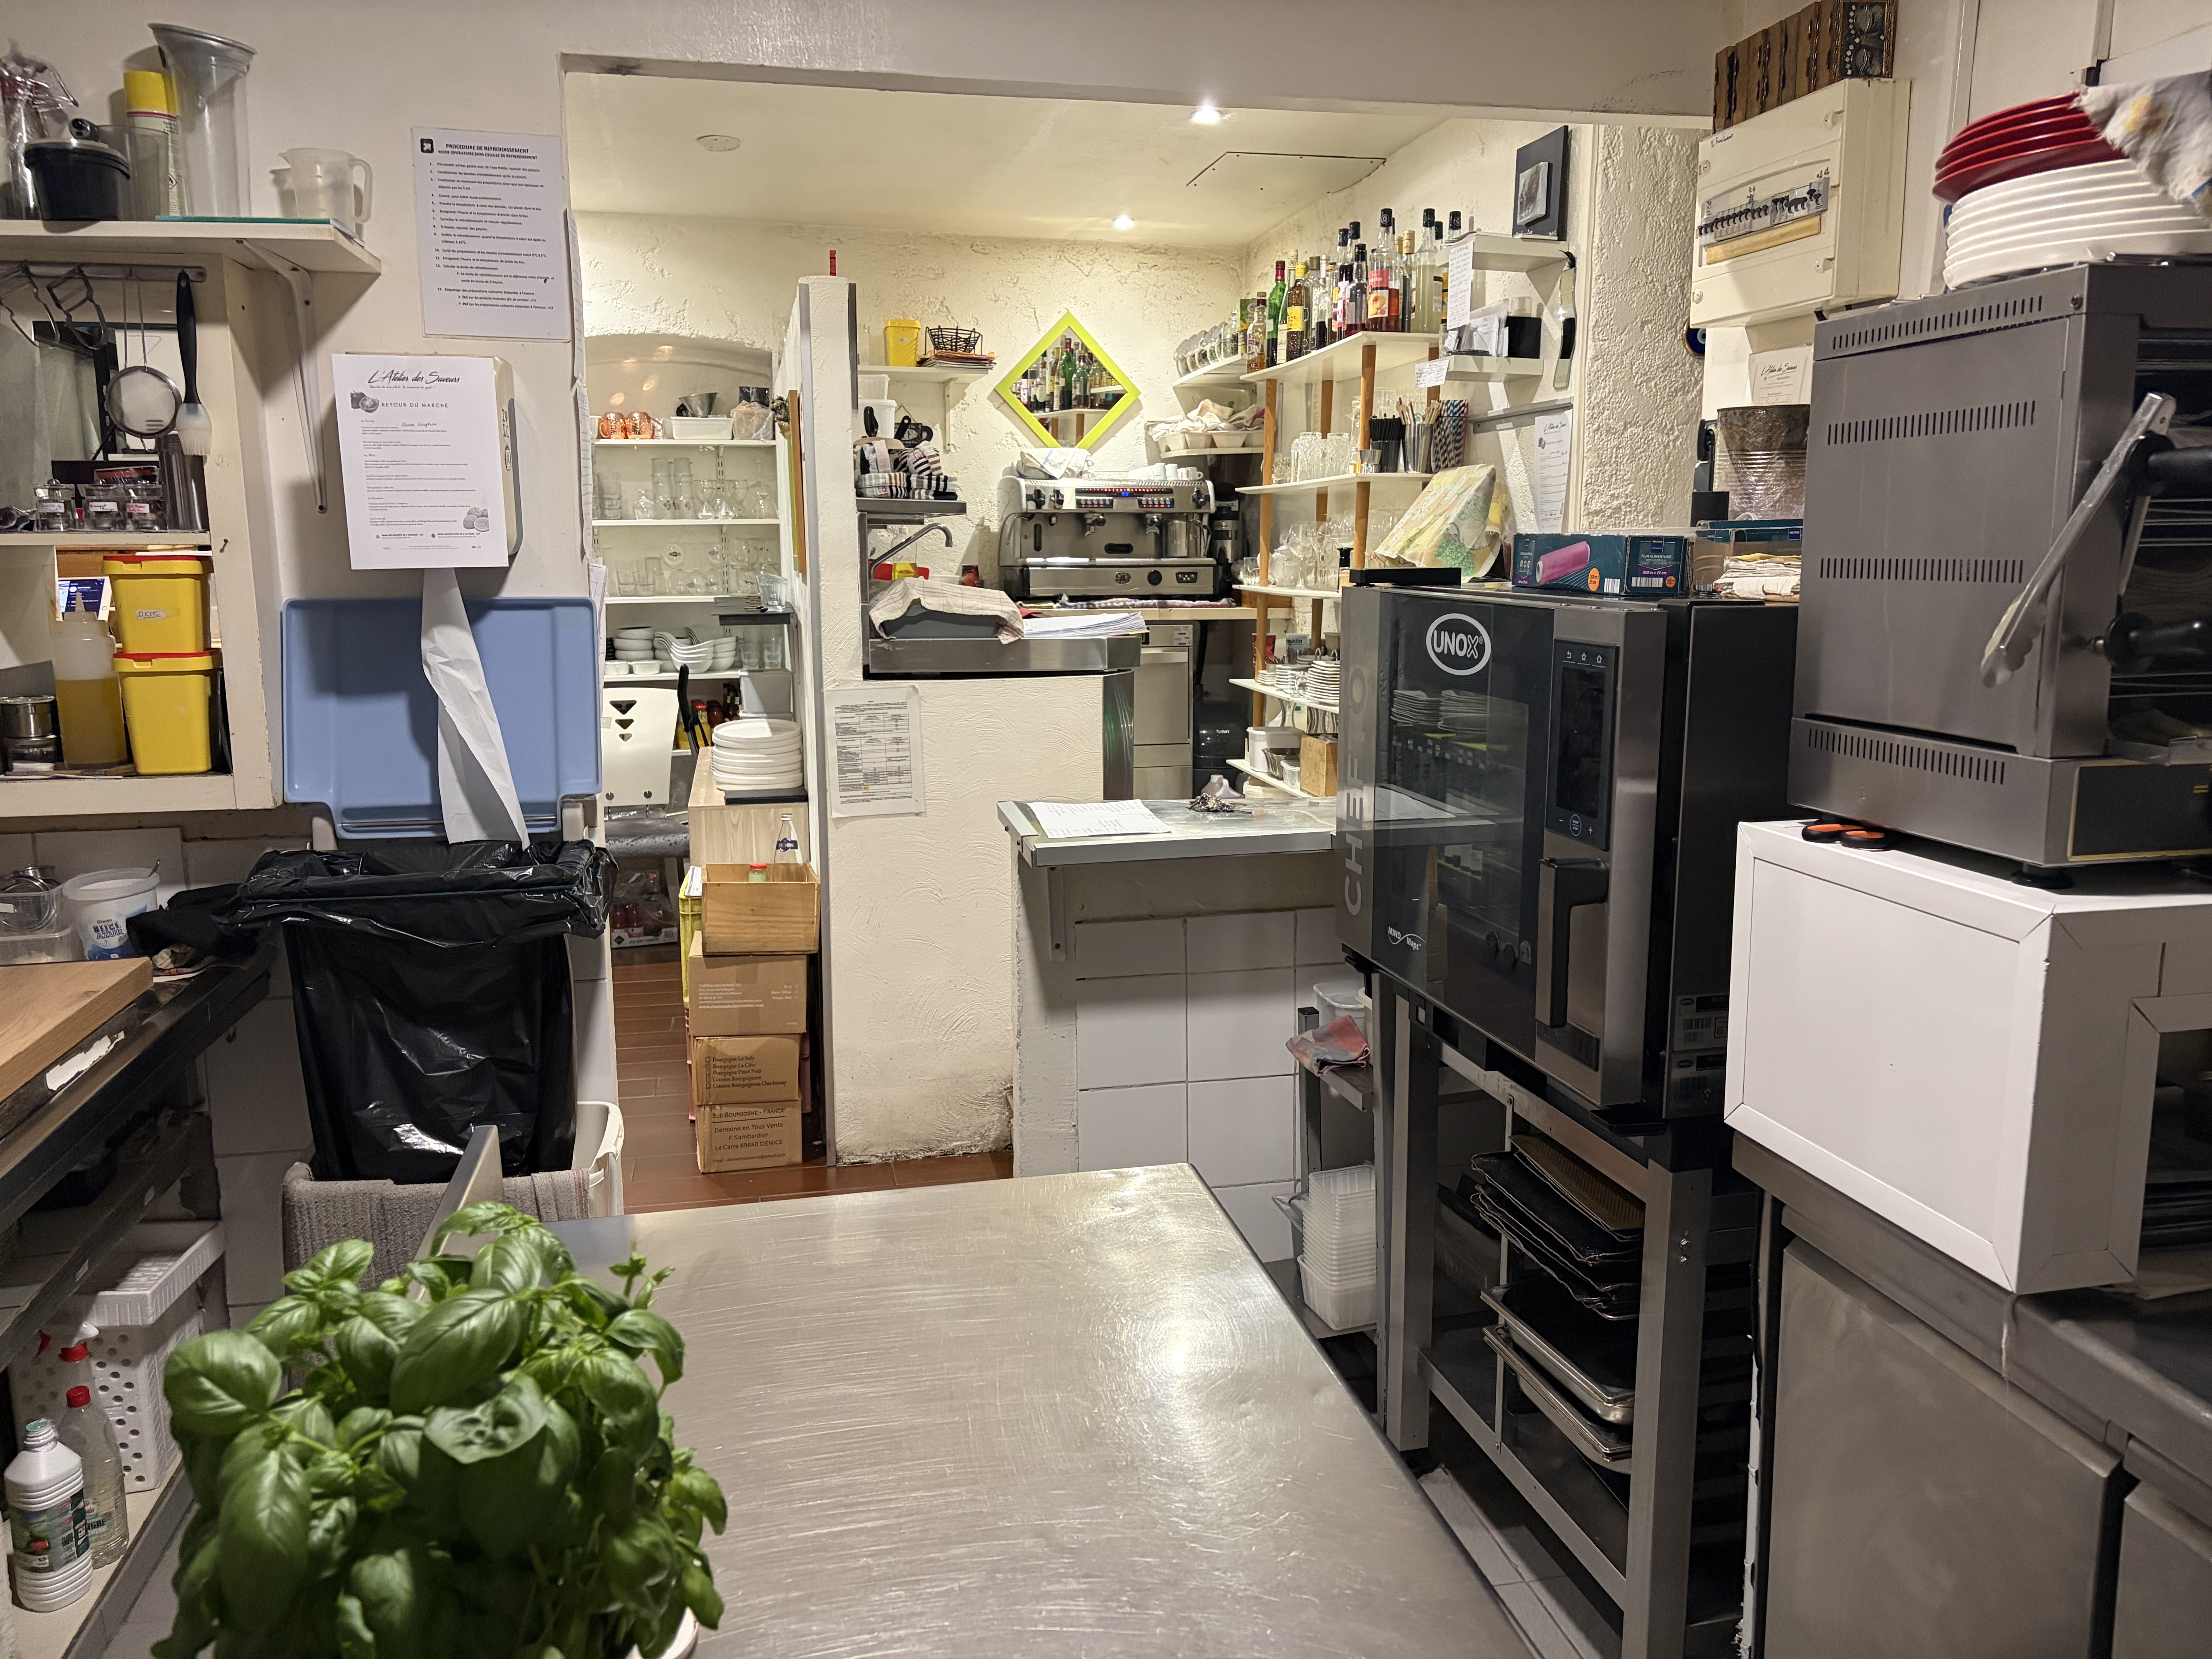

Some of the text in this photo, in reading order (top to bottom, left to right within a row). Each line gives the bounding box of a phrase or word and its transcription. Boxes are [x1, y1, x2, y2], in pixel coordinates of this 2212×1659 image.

[368, 369, 460, 385] L'Atelier des Saveurs
[1434, 630, 1479, 659] UNOX
[97, 929, 124, 939] AZUR
[1388, 926, 1401, 939] MIND
[1407, 937, 1419, 950] Maps
